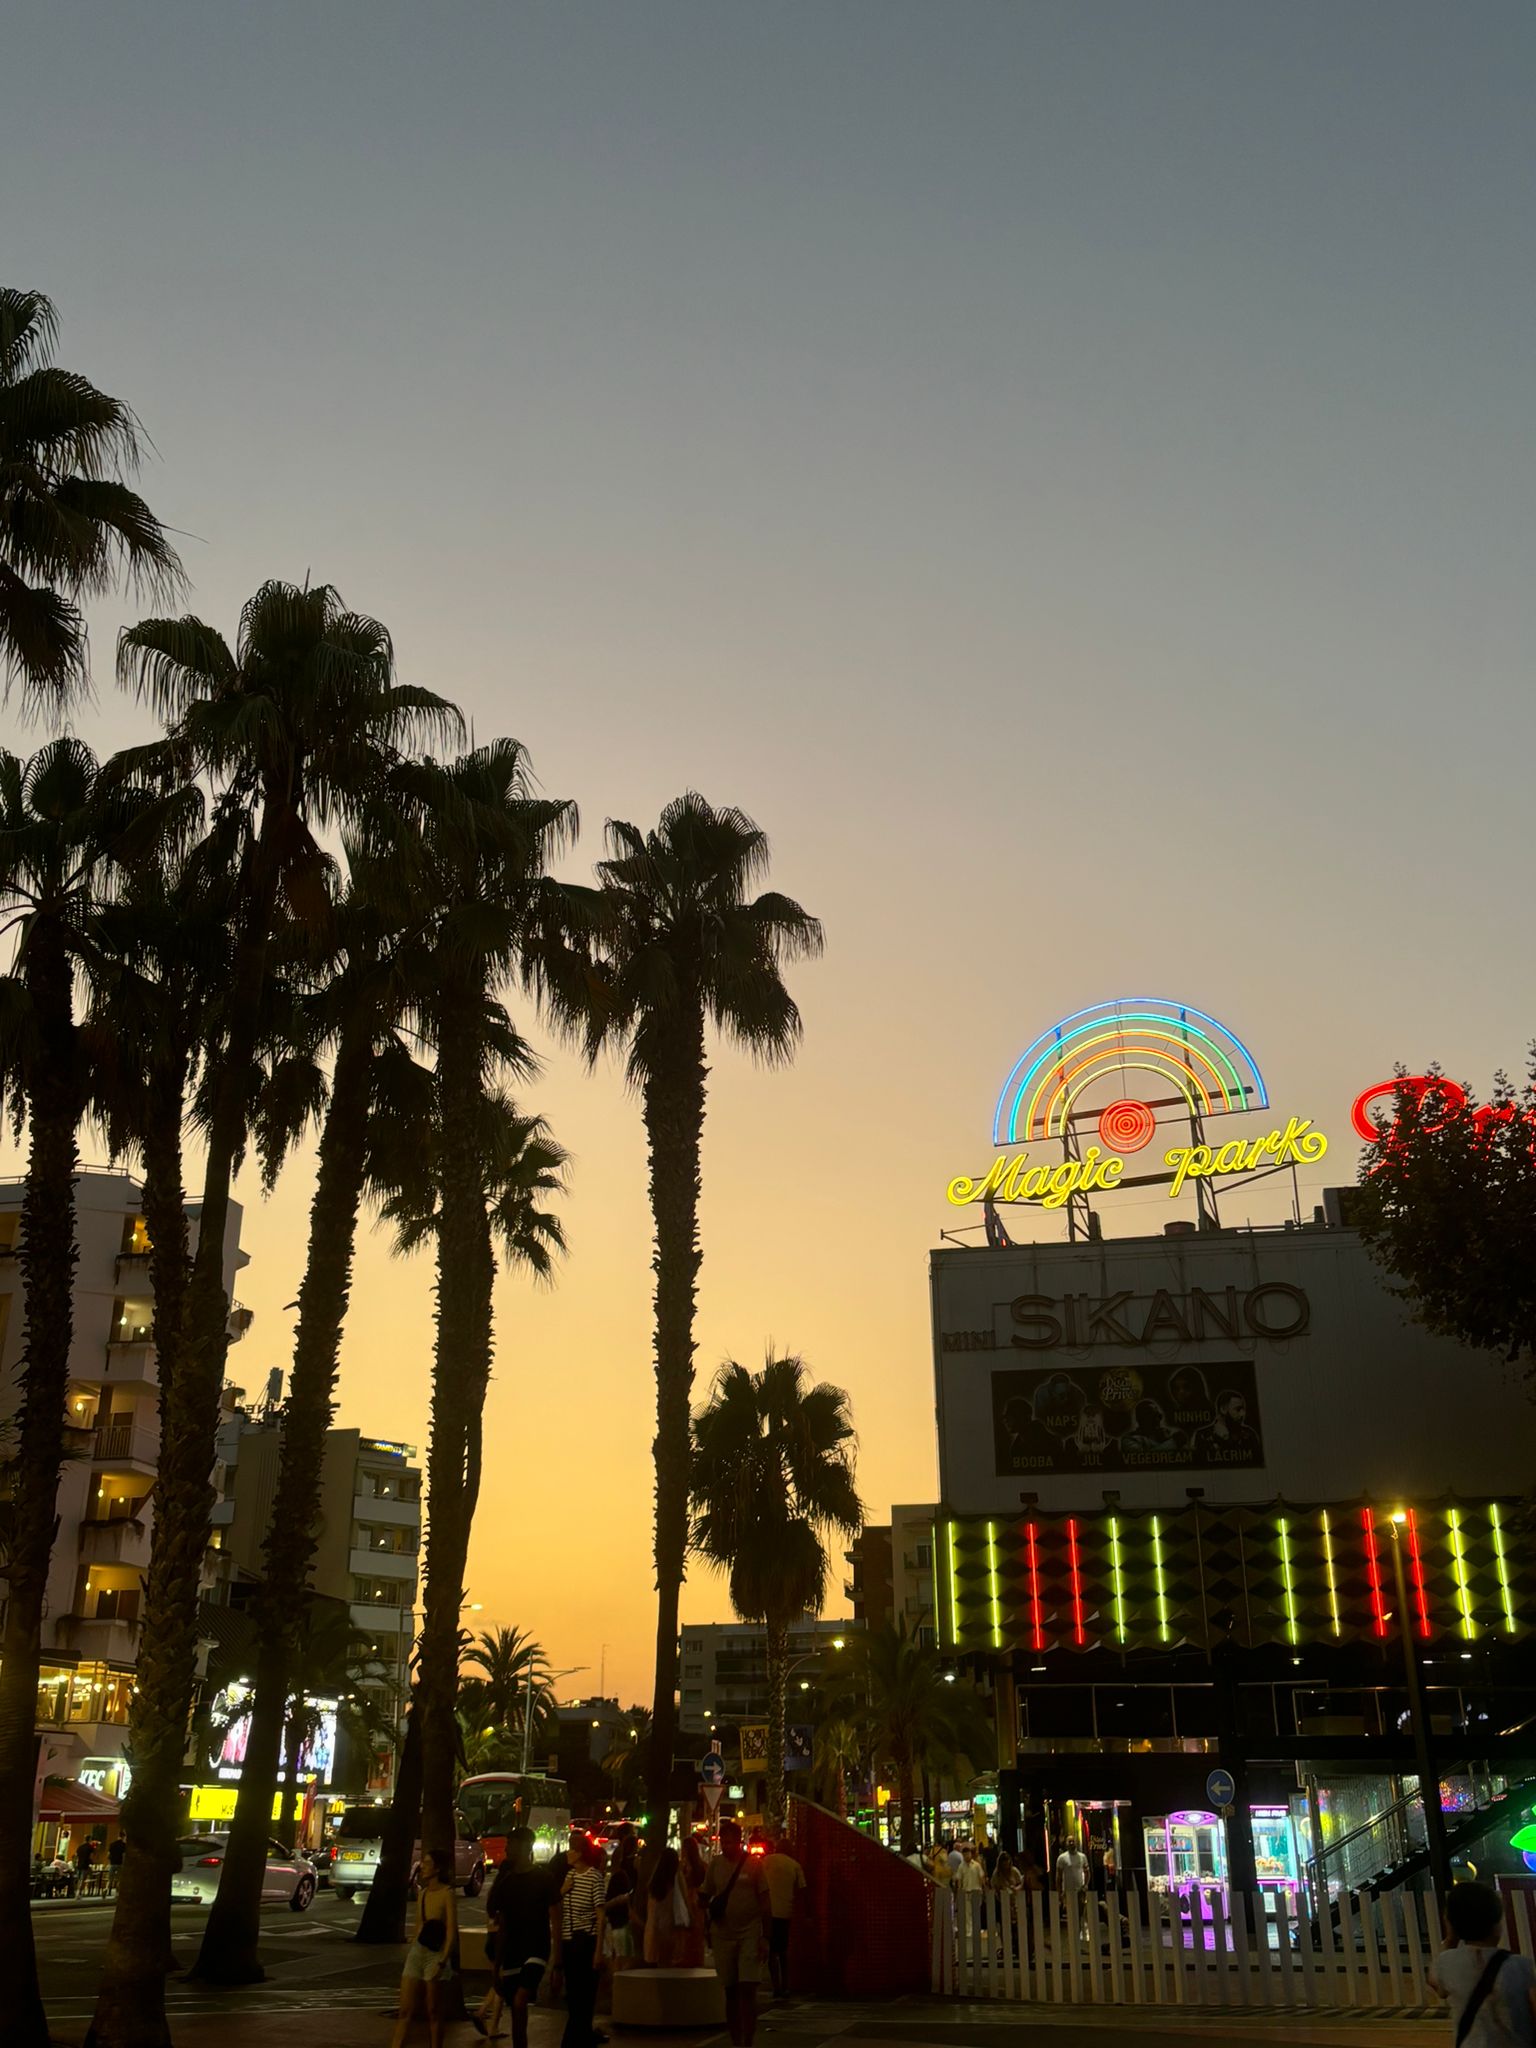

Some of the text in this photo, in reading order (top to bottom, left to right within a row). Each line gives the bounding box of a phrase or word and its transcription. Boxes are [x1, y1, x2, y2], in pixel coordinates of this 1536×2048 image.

[947, 1147, 1124, 1209] Magic
[1164, 1116, 1328, 1198] park
[1010, 1282, 1310, 1348] SIKANO
[1046, 1415, 1079, 1427] NAPS
[1173, 1410, 1212, 1424] NINHO
[1012, 1456, 1055, 1469] BOOBA
[1081, 1453, 1104, 1467] JUL
[78, 1769, 106, 1792] KFC
